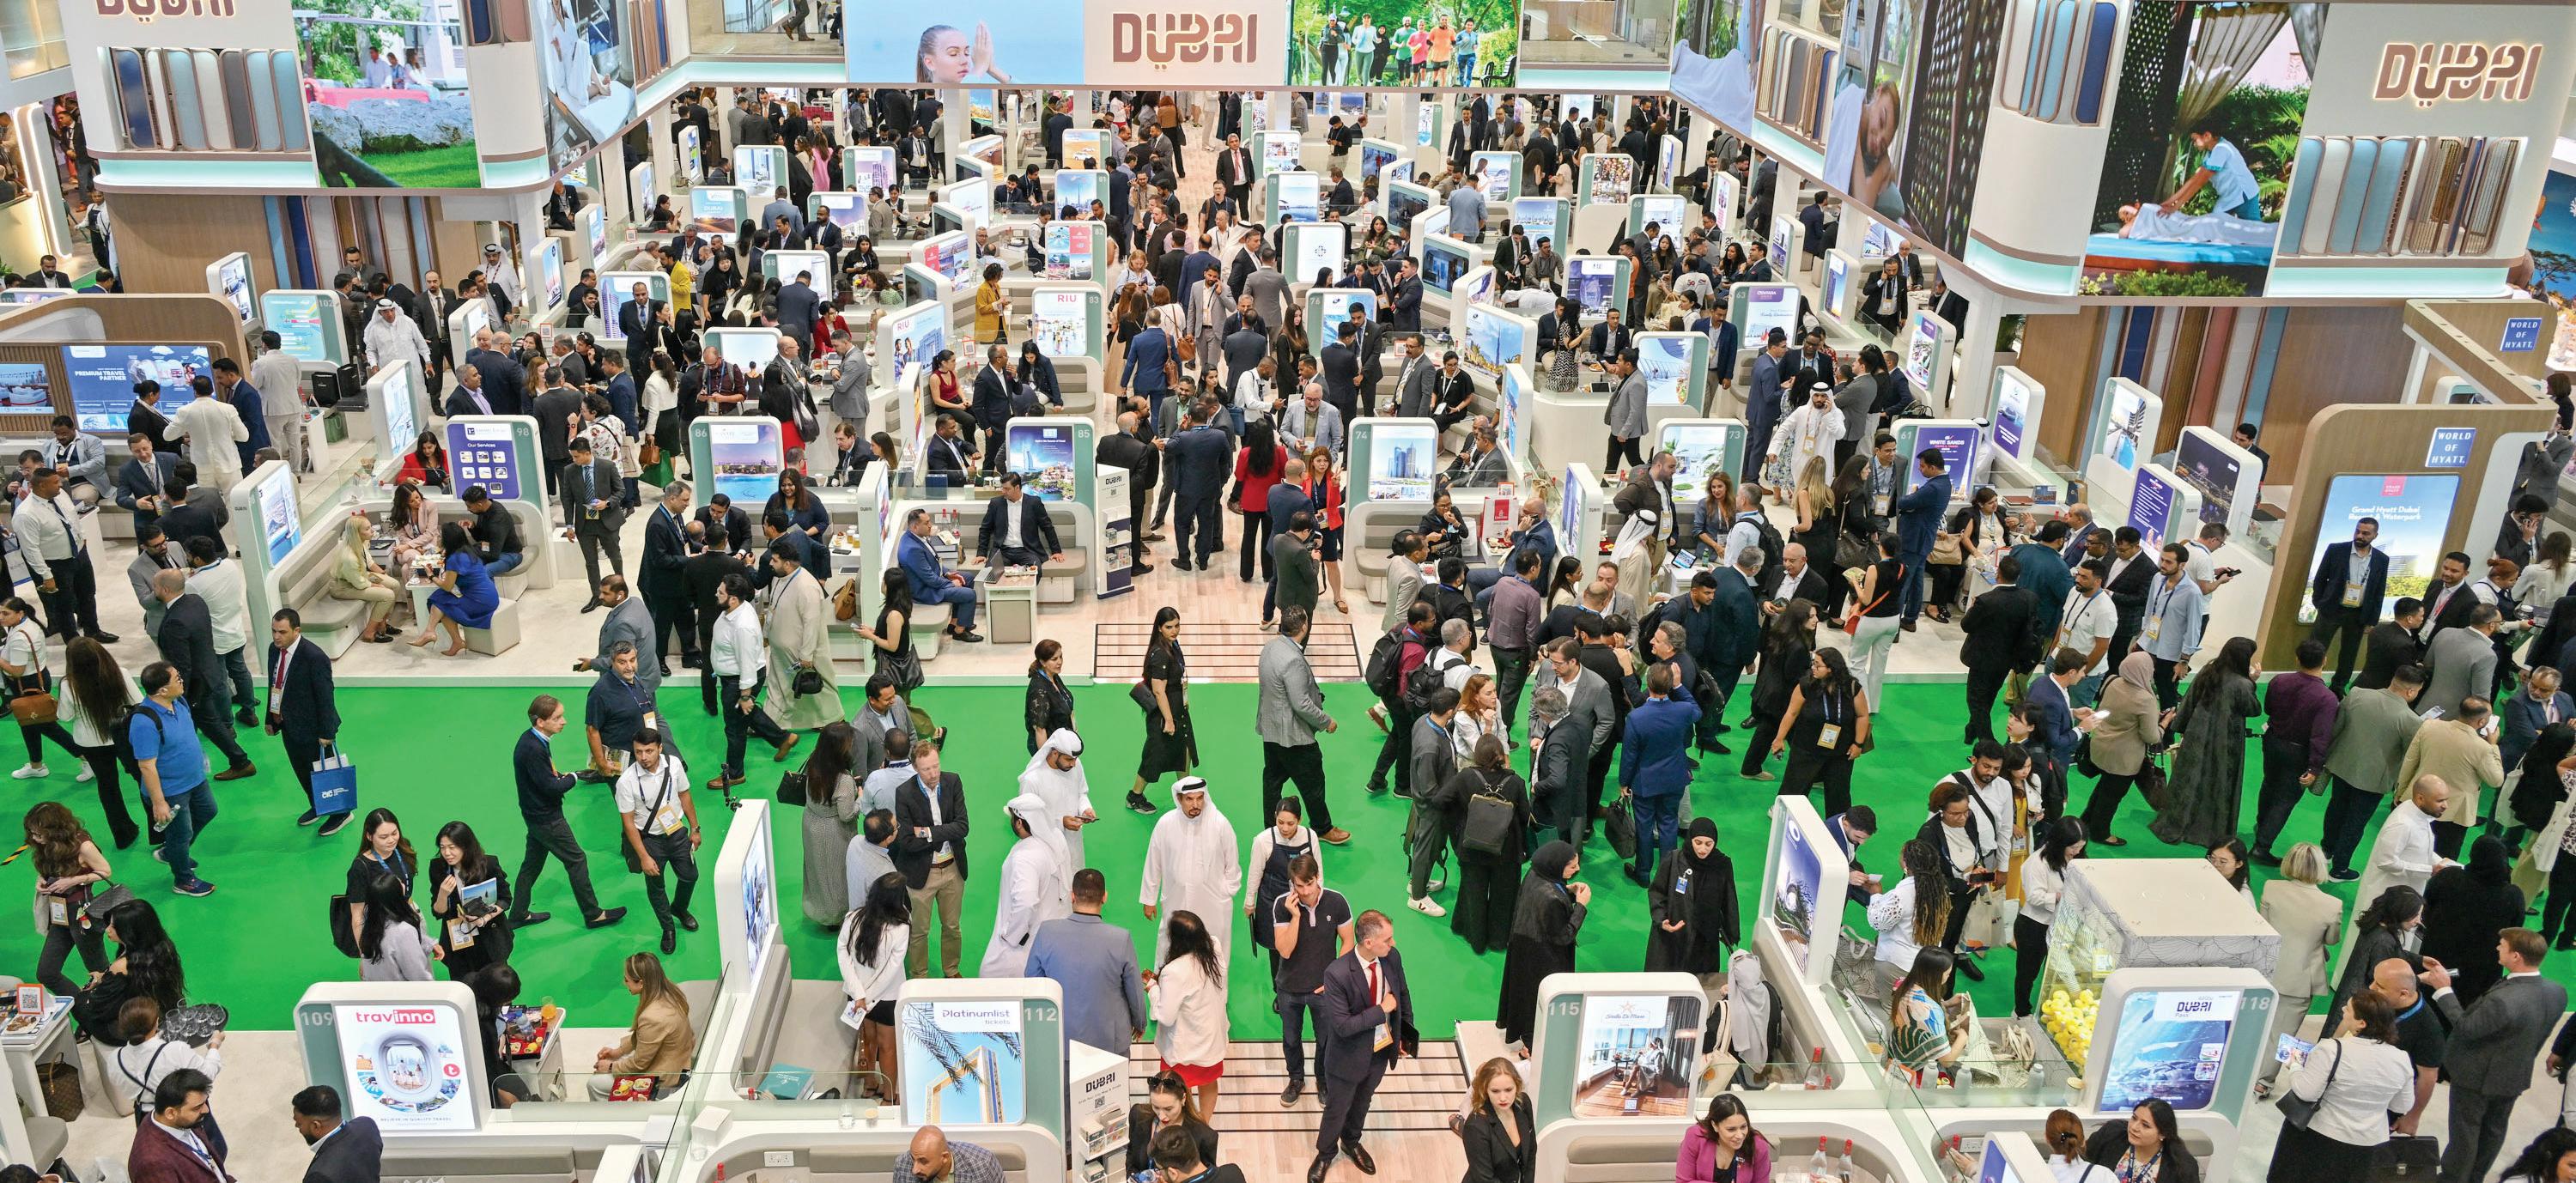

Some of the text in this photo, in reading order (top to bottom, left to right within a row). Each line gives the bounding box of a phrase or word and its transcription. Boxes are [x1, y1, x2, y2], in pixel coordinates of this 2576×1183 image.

[1113, 14, 1257, 70] DUBAI
[2374, 44, 2543, 106] DUBAI
[653, 280, 665, 288] 96
[319, 299, 334, 307] 102
[896, 320, 909, 331] RIU
[516, 428, 530, 436] 98
[695, 428, 708, 438] 86
[1078, 429, 1091, 438] 85
[1728, 430, 1741, 440] 73
[1900, 431, 1912, 440] 61
[2375, 506, 2398, 515] Hyatt
[1548, 1002, 1581, 1016] 115
[2177, 1001, 2213, 1012] DUBAI
[2239, 997, 2270, 1010] 118
[301, 1011, 334, 1026] 109
[356, 1010, 435, 1024] travinno
[943, 1010, 1010, 1018] Platinumlist
[1024, 1007, 1057, 1022] 112
[1085, 1072, 1115, 1093] DUBAI
